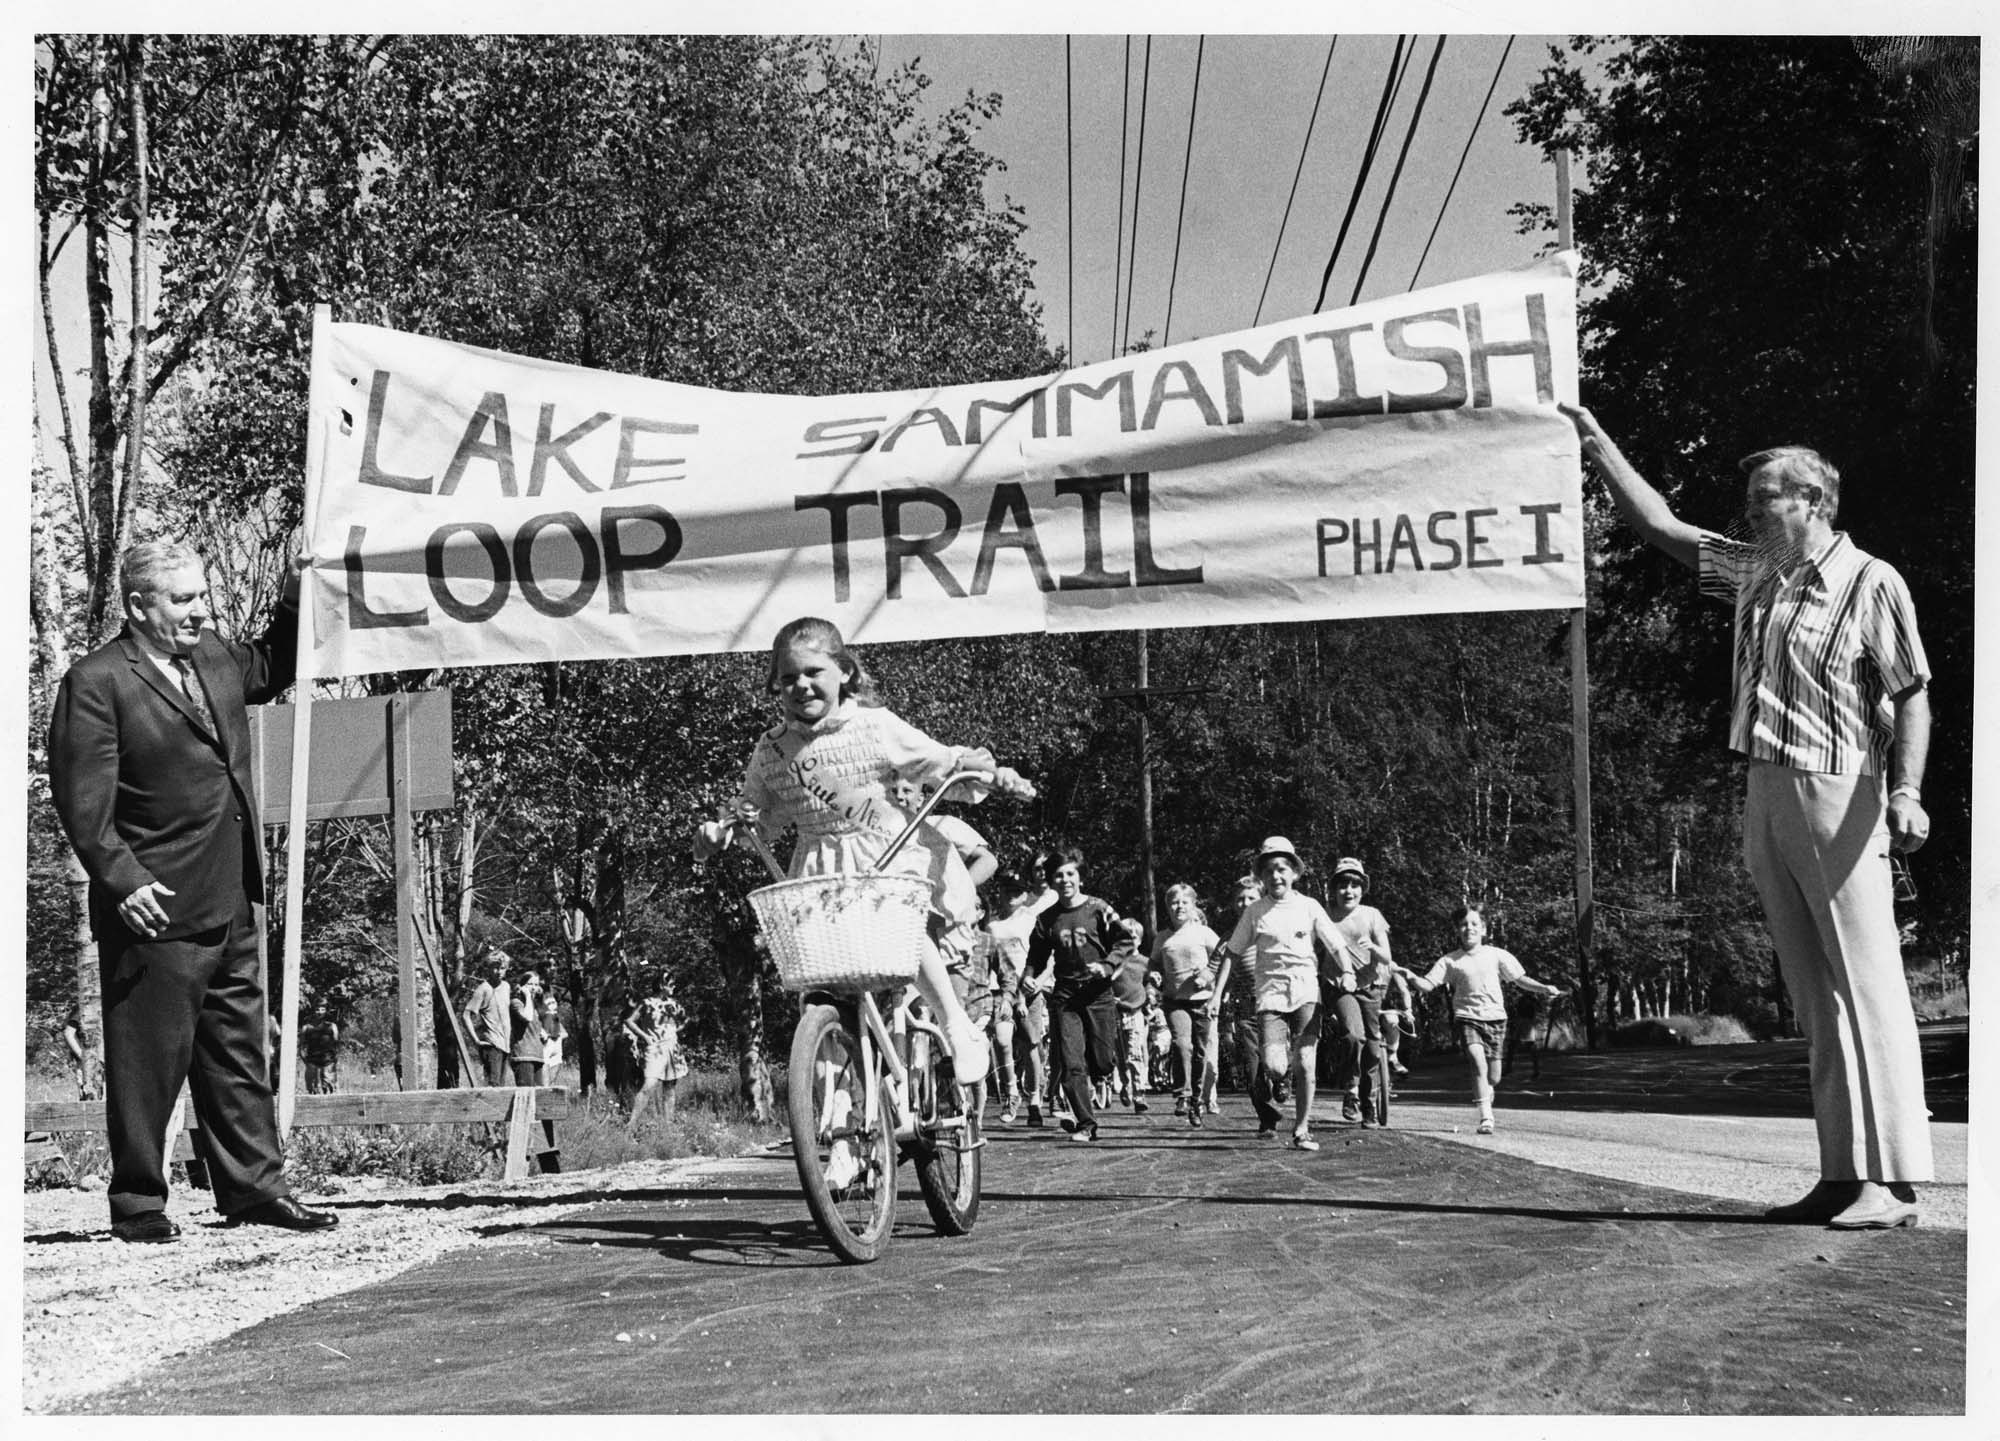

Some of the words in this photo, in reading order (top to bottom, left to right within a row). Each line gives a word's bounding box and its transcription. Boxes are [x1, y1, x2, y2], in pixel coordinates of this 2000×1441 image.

[358, 369, 699, 497] LAKE
[795, 293, 1554, 459] SAMMAMISH
[344, 504, 683, 630] LOOP
[795, 472, 1204, 603] TRAIL
[1317, 508, 1504, 577] PHASE
[1520, 503, 1564, 565] I
